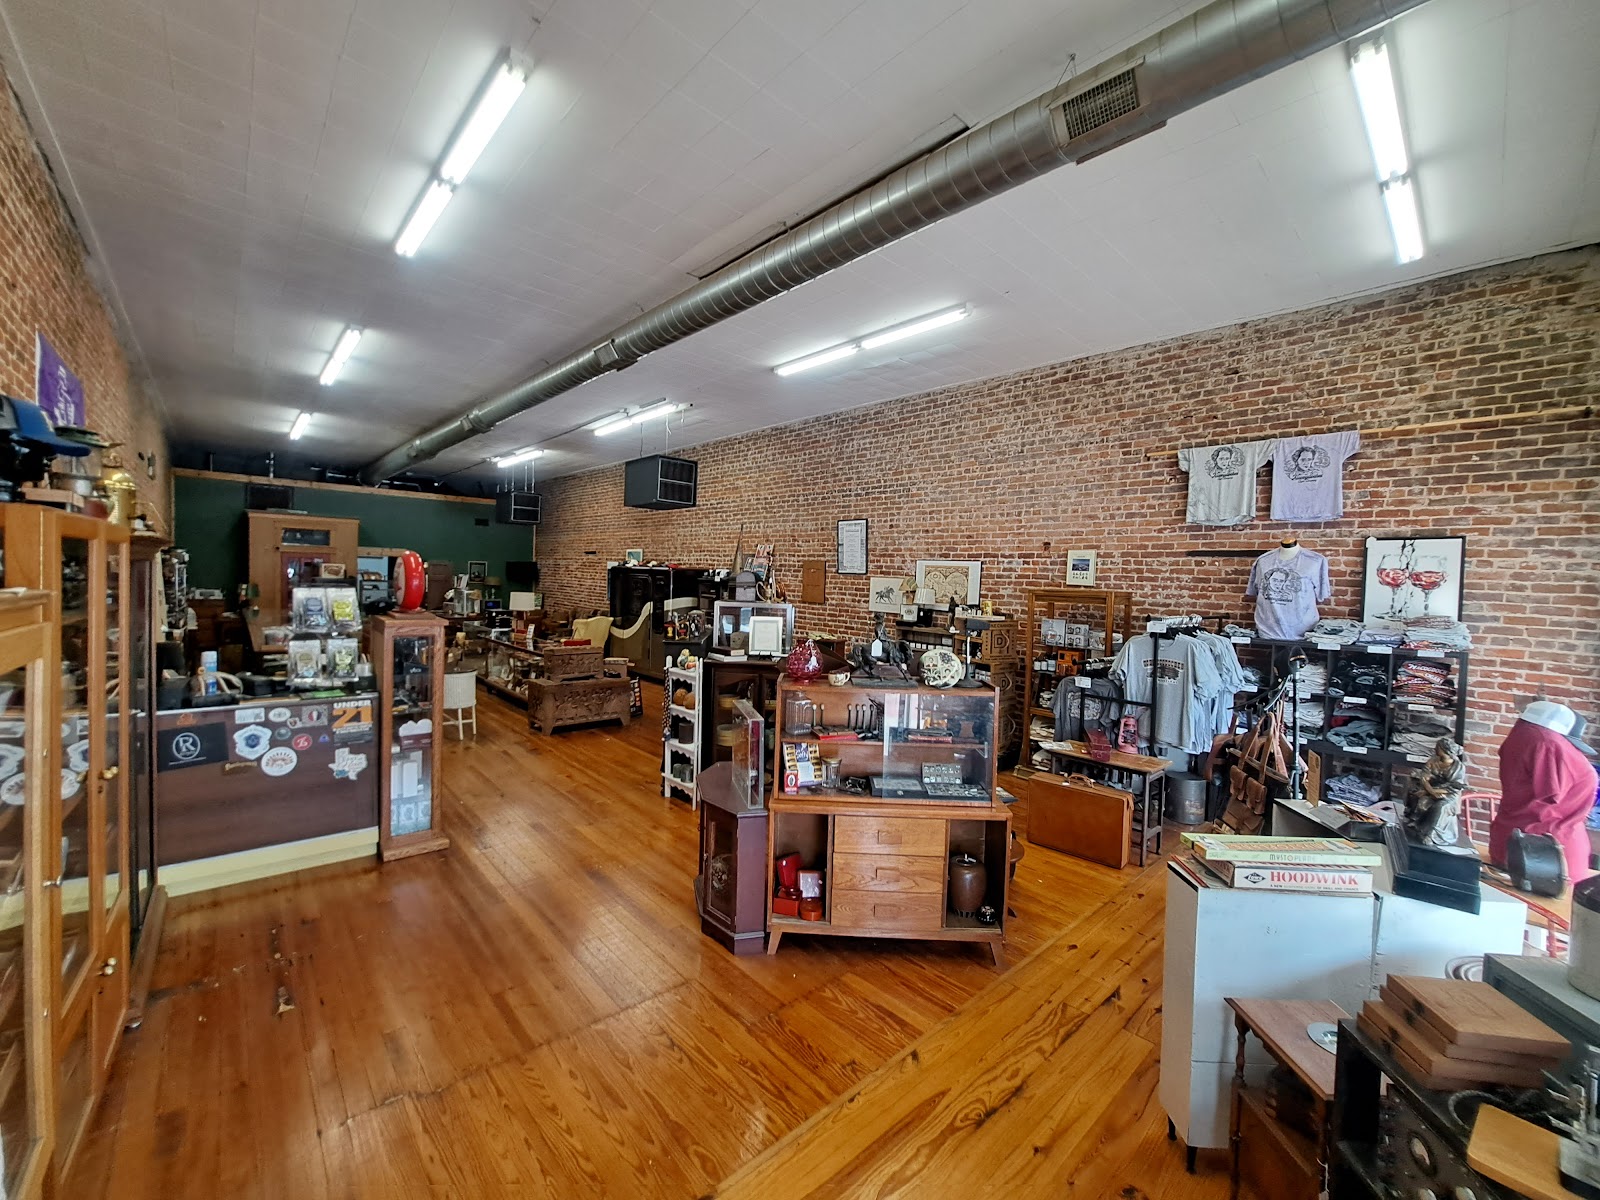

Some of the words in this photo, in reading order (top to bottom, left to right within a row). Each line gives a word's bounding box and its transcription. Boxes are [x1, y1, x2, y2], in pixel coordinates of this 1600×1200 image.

[333, 700, 371, 709] UNDER
[332, 706, 373, 729] 21
[1270, 871, 1359, 885] HOODWINK
